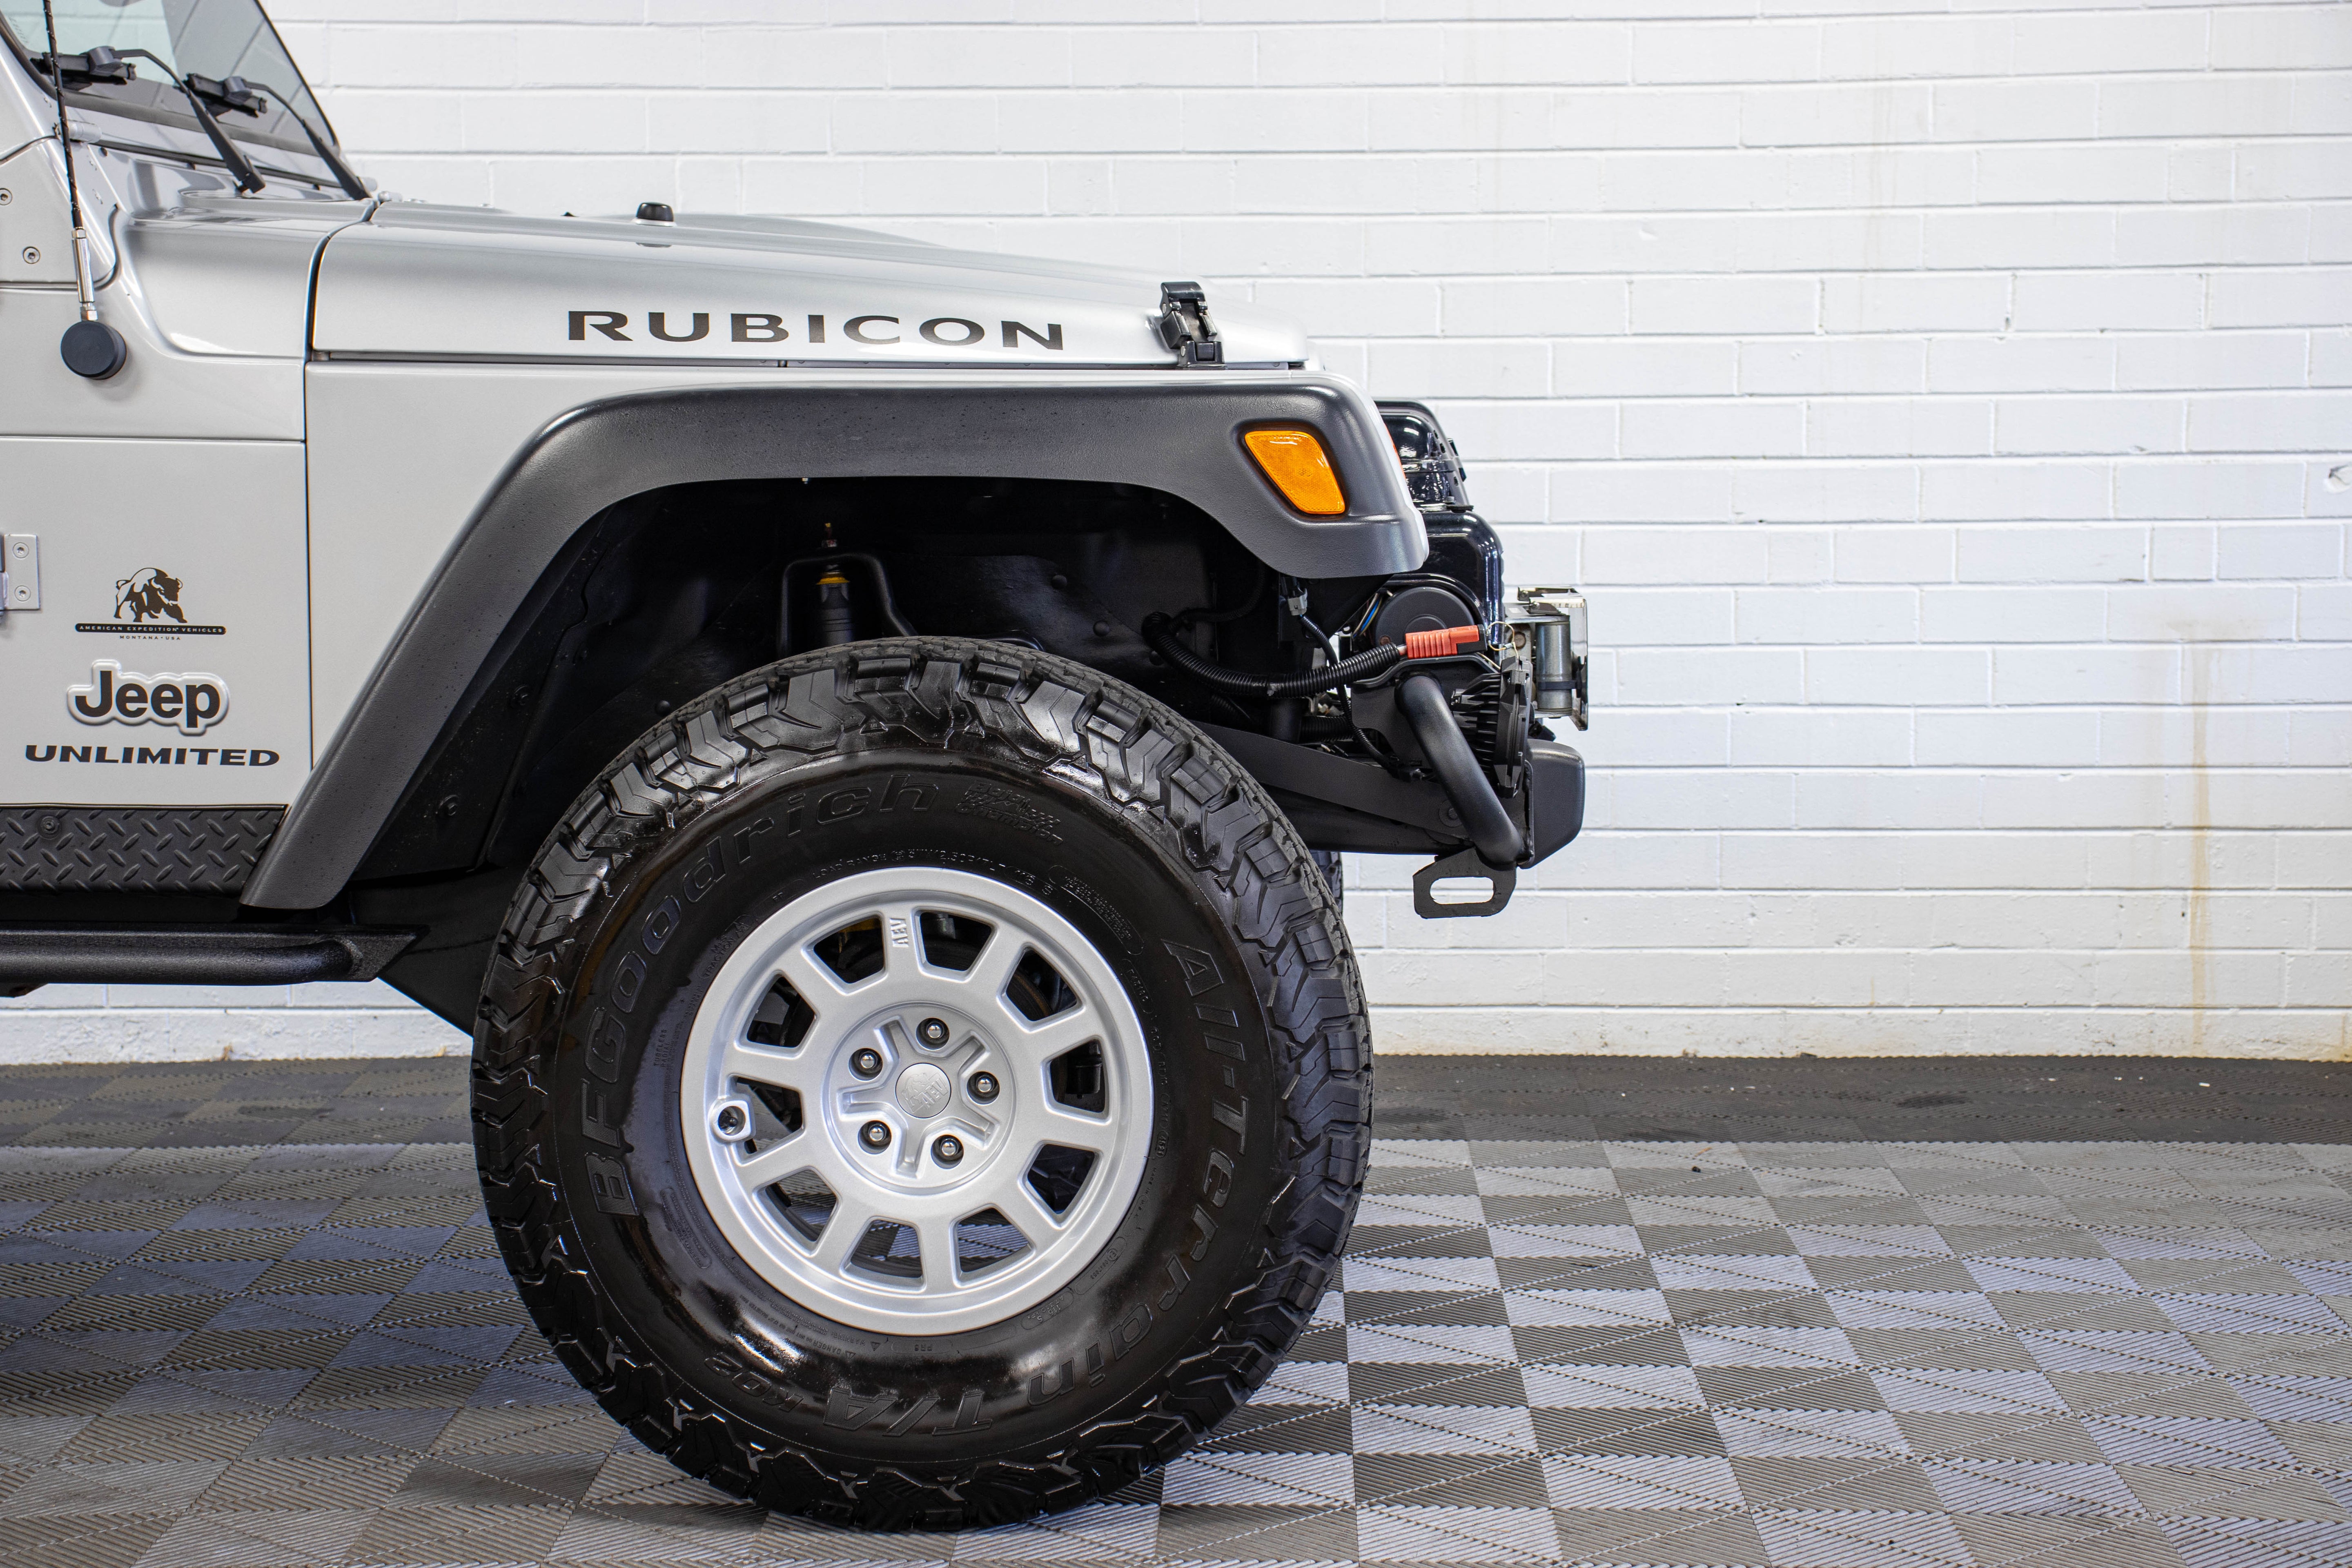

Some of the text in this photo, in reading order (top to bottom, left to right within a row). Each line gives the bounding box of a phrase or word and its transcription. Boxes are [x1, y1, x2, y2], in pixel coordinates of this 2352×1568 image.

[568, 310, 1064, 350] RUBICON
[75, 670, 220, 728] Jeep
[25, 745, 280, 766] UNLIMITED
[702, 935, 736, 978] TRACTION
[580, 773, 939, 1216] BFGoodrich
[1027, 939, 1249, 1406] All-Terrain
[1036, 1303, 1062, 1323] 116 S
[812, 1339, 842, 1355] DANGER
[822, 1387, 993, 1437] T/A
